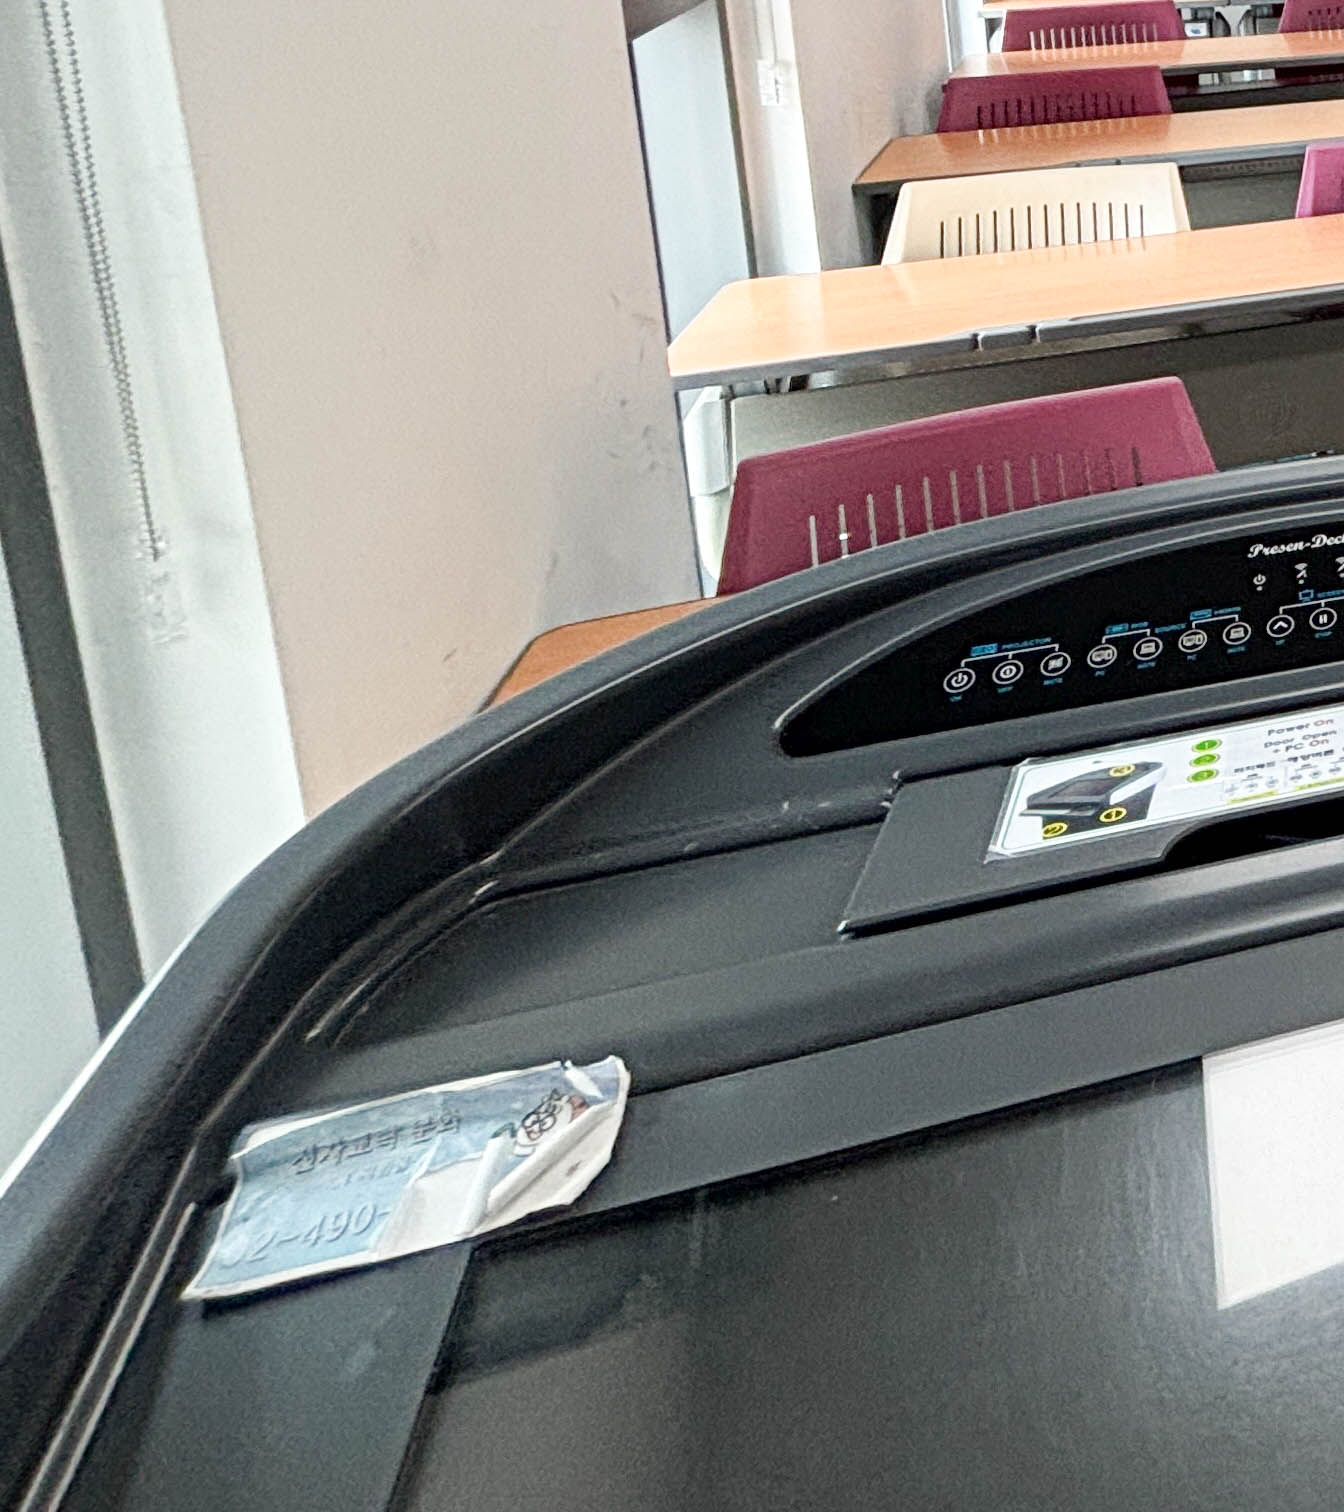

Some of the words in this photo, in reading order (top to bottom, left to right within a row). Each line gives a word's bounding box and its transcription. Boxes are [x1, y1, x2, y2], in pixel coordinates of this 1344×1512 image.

[1267, 722, 1310, 736] Power
[1313, 717, 1334, 727] On
[1264, 737, 1295, 749] Door
[1302, 729, 1338, 742] Open
[1285, 742, 1304, 753] PC
[1309, 738, 1329, 748] On
